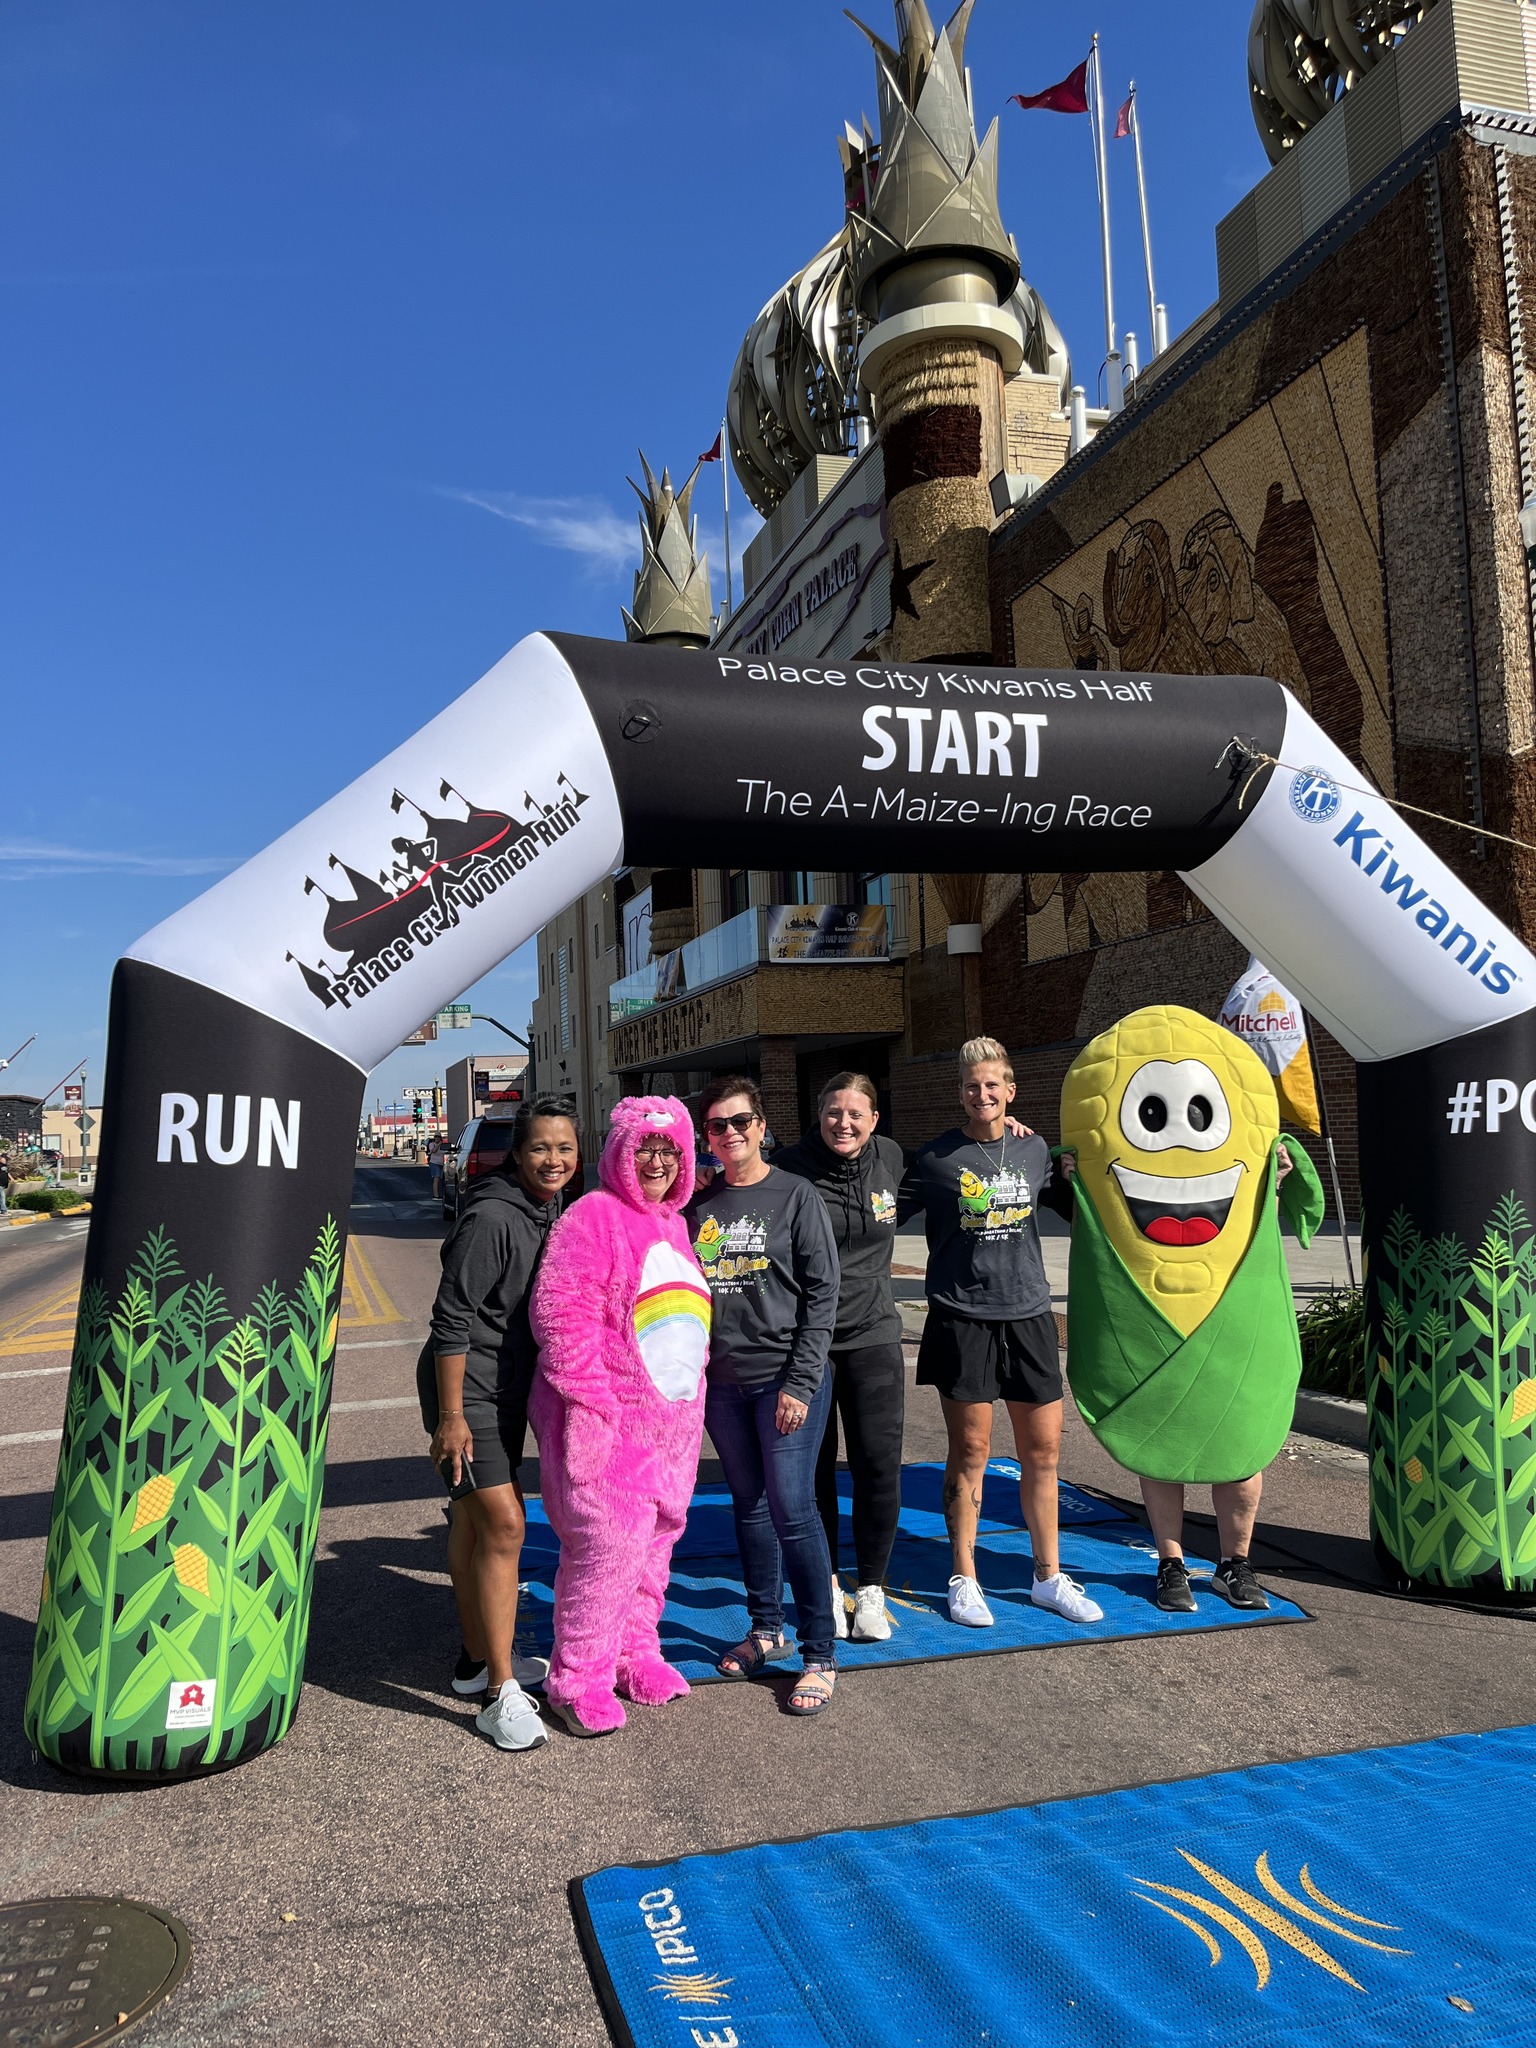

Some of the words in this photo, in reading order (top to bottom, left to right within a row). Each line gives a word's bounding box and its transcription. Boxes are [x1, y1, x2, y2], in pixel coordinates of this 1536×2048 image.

[770, 592, 802, 650] CORN
[804, 542, 859, 618] PALACE
[718, 657, 847, 687] Palace
[855, 668, 929, 699] City
[937, 672, 1077, 700] Kiwanis
[1080, 678, 1154, 703] Half
[861, 704, 1049, 778] START
[736, 778, 812, 816] The
[820, 784, 1057, 834] A-Maize-Ing
[1064, 794, 1152, 829] Race
[1293, 774, 1337, 819] INTERNATIONAL
[329, 938, 414, 1010] Palace
[408, 893, 461, 948] City
[451, 838, 541, 910] Women
[534, 800, 582, 848] Run
[1333, 810, 1517, 995] Kiwanis
[613, 1025, 640, 1067] UNDER
[641, 1016, 659, 1059] THE
[662, 1008, 680, 1055] BIG
[680, 999, 703, 1048] TOP
[1221, 1011, 1297, 1032] Mitchell
[157, 1092, 301, 1170] RUN
[185, 1706, 211, 1714] VISUALS
[639, 1887, 699, 1966] IPICO
